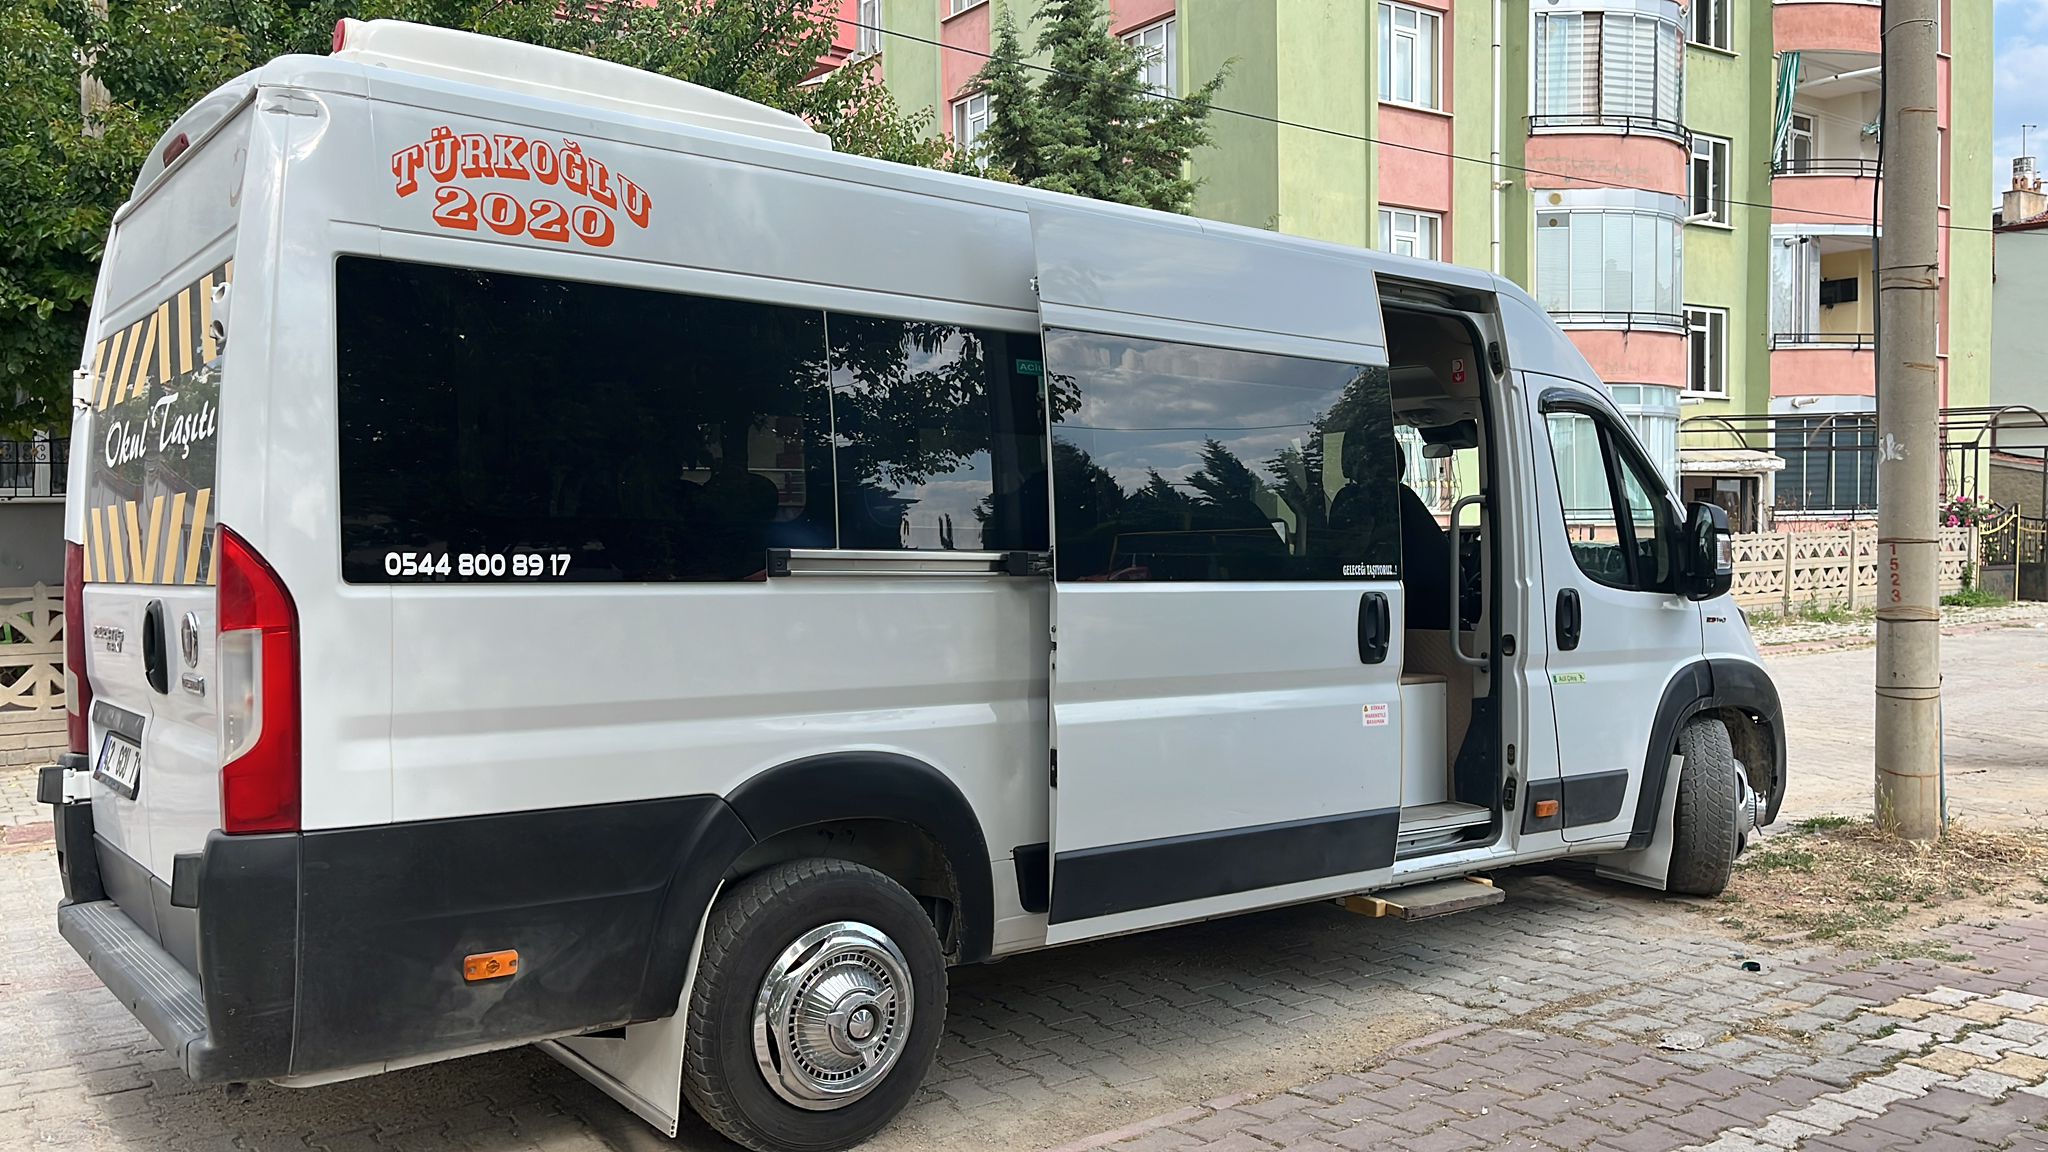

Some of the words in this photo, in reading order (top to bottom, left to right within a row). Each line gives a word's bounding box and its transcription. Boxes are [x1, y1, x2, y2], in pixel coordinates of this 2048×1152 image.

[391, 126, 652, 229] TÜRKOĞLU
[432, 186, 615, 248] 2020
[105, 418, 149, 468] Okul
[152, 392, 216, 459] Taşıtı
[385, 552, 452, 576] 0544
[458, 553, 506, 577] 800
[512, 553, 544, 577] 89
[550, 554, 572, 576] 17
